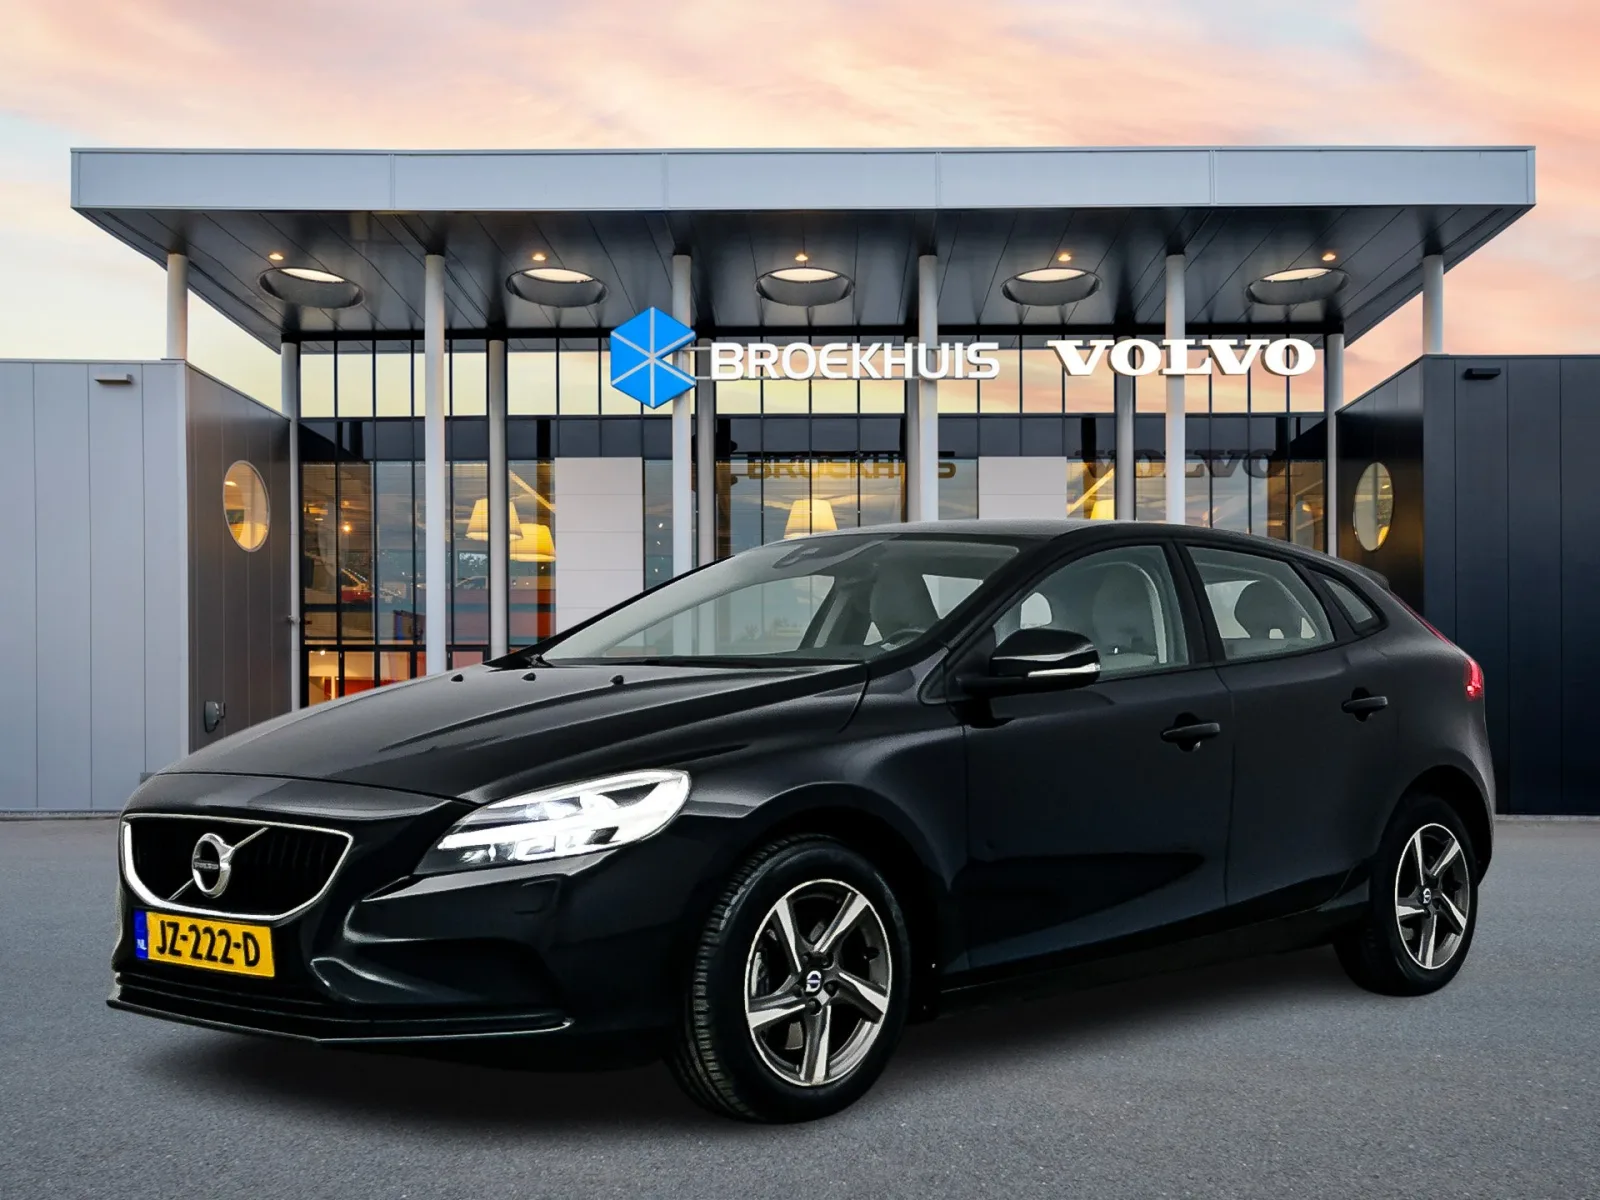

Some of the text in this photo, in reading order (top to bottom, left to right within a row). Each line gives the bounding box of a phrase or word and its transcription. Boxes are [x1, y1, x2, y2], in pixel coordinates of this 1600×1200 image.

[711, 342, 999, 379] BROEKHUIS
[1045, 338, 1316, 376] VOLVO
[747, 452, 957, 479] BROEKHS
[156, 919, 260, 968] JZ-222-D
